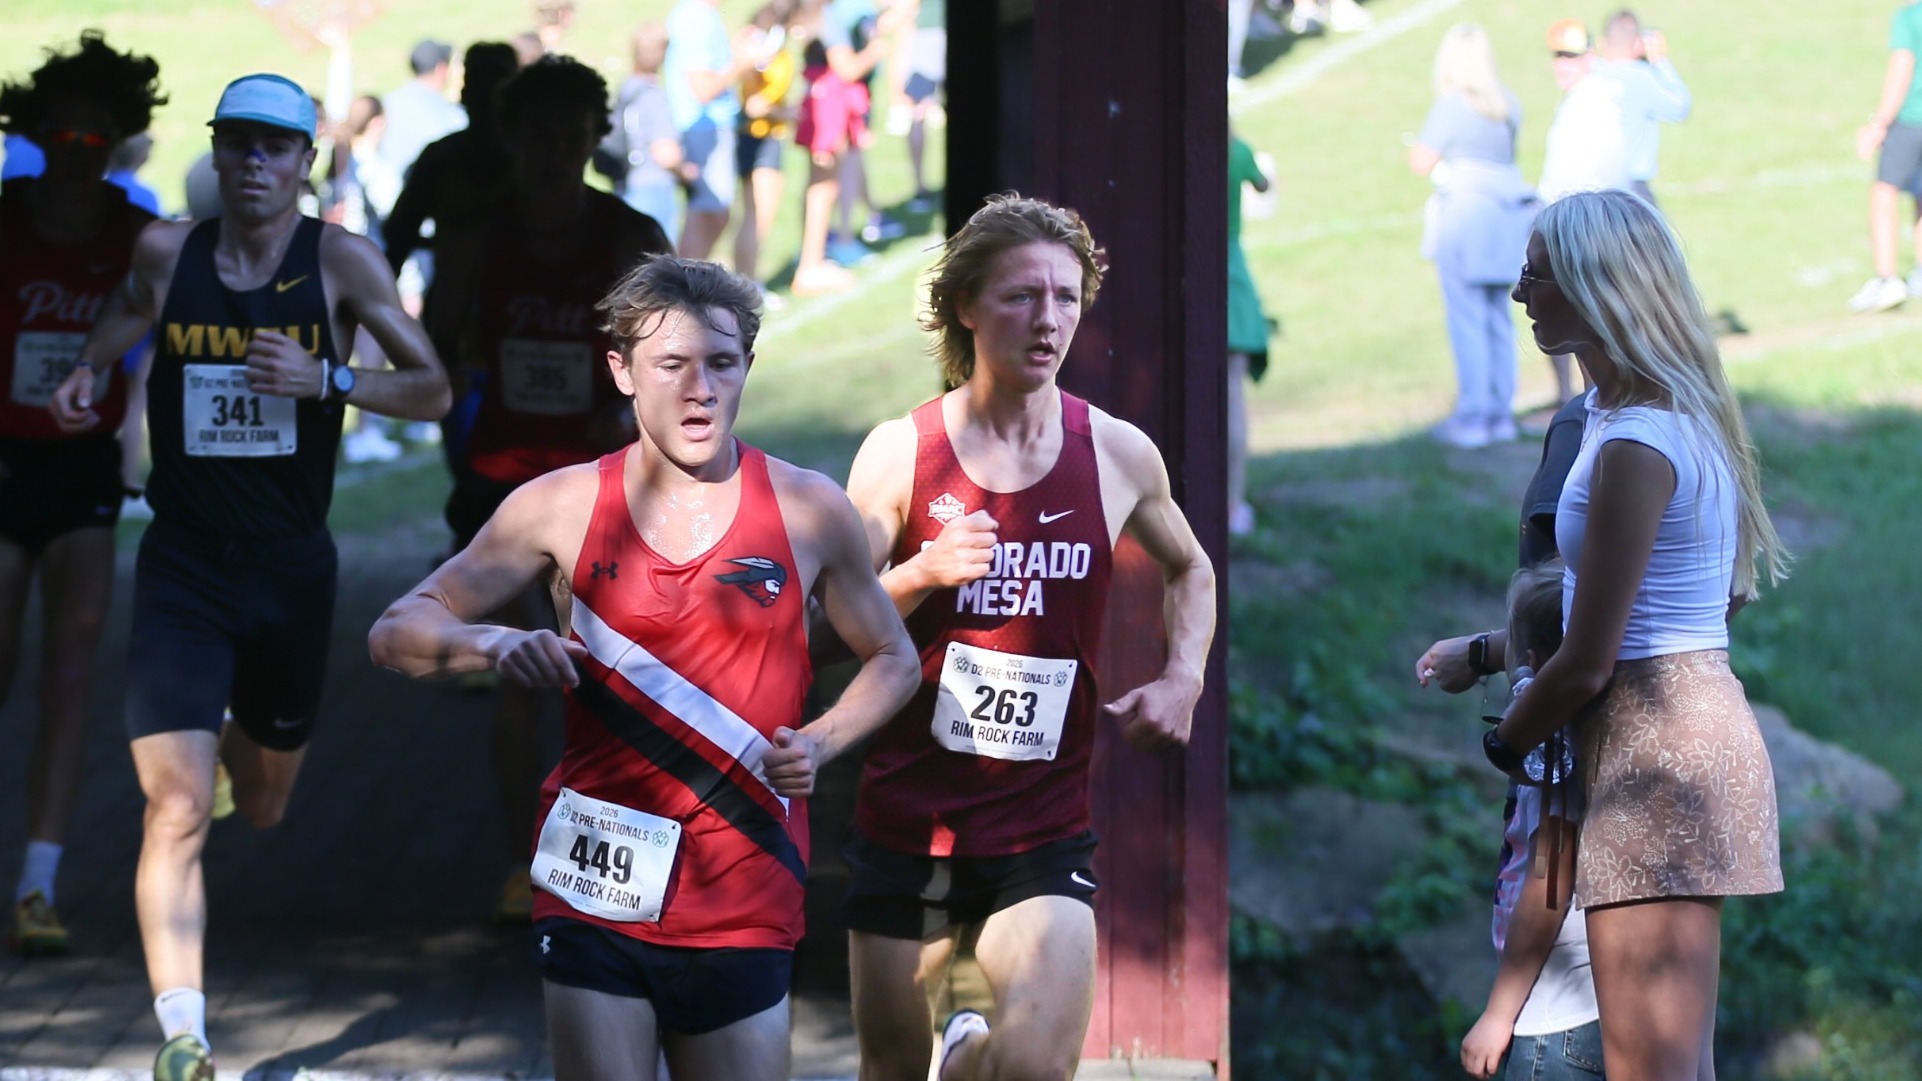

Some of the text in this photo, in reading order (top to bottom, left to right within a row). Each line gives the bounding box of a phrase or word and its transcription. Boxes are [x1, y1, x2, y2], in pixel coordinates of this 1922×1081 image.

[166, 322, 320, 357] MWU
[212, 395, 264, 426] 341
[199, 429, 279, 443] RIM ROCK FARM
[931, 504, 963, 515] RMAC
[956, 579, 1044, 616] MESA
[971, 664, 1051, 685] D2 PRE-NATIONALS
[1006, 658, 1023, 669] 2026
[970, 685, 1038, 727] 263
[950, 720, 1044, 746] RIM ROCK FARM
[600, 806, 619, 818] 2026
[578, 813, 650, 842] PRE-NATIONALS
[569, 834, 634, 884] 449
[547, 868, 573, 889] RIM
[573, 876, 607, 900] ROCK
[607, 887, 641, 911] FARM
